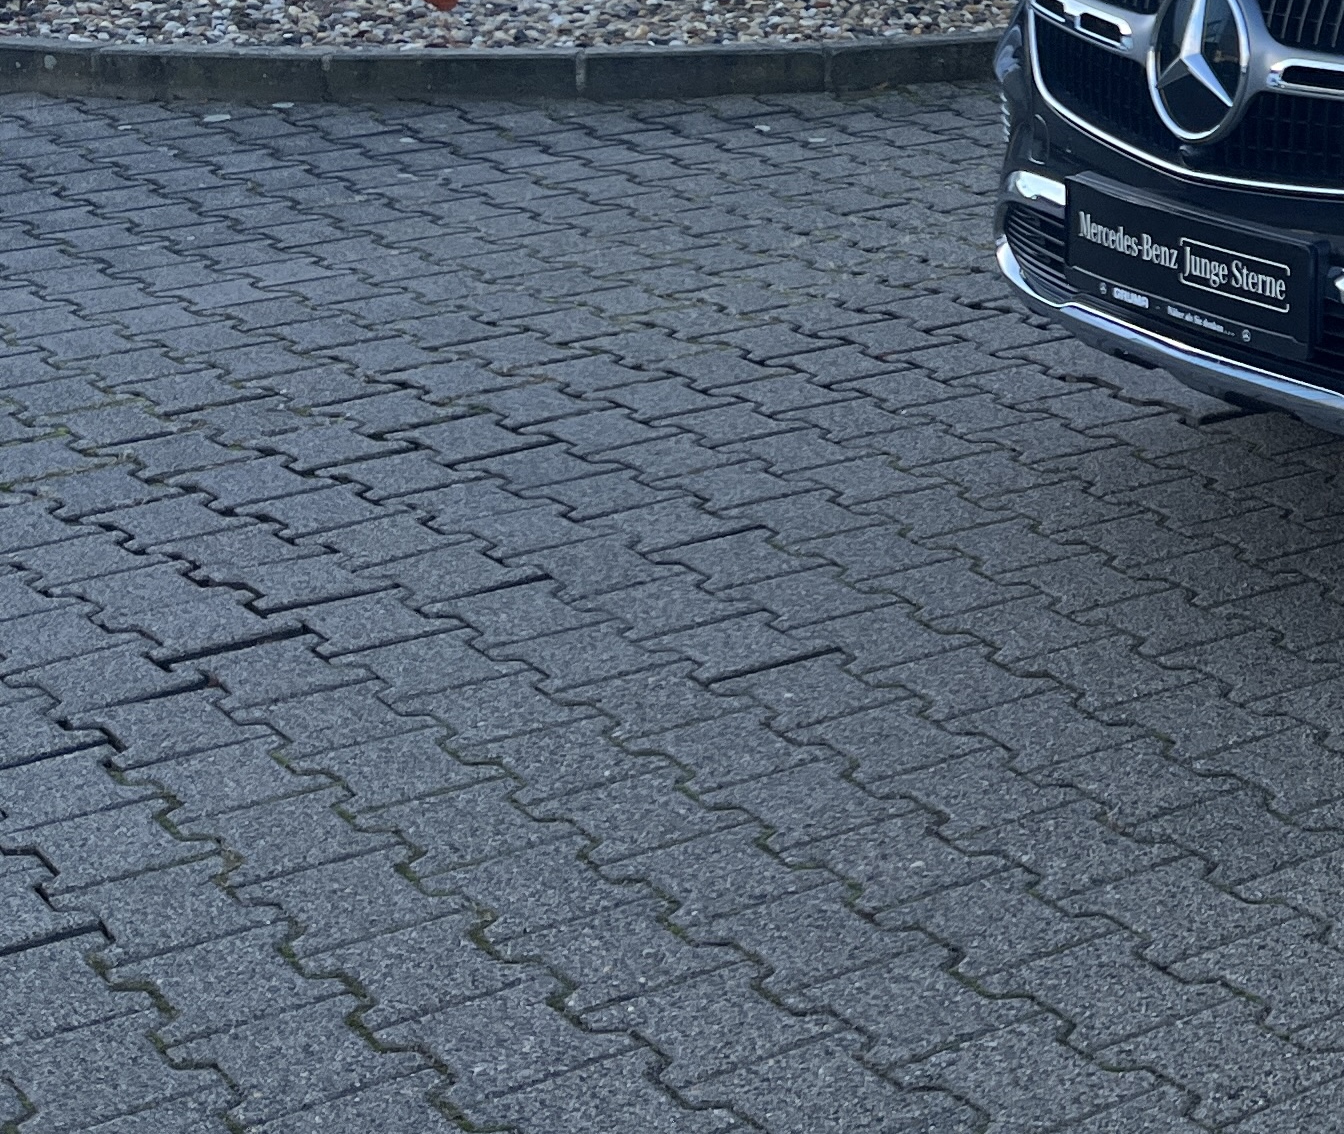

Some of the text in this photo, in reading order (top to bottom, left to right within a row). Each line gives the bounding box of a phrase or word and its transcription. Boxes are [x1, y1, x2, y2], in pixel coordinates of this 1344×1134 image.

[1078, 211, 1287, 300] Mercedes-Benz Junge Sterne
